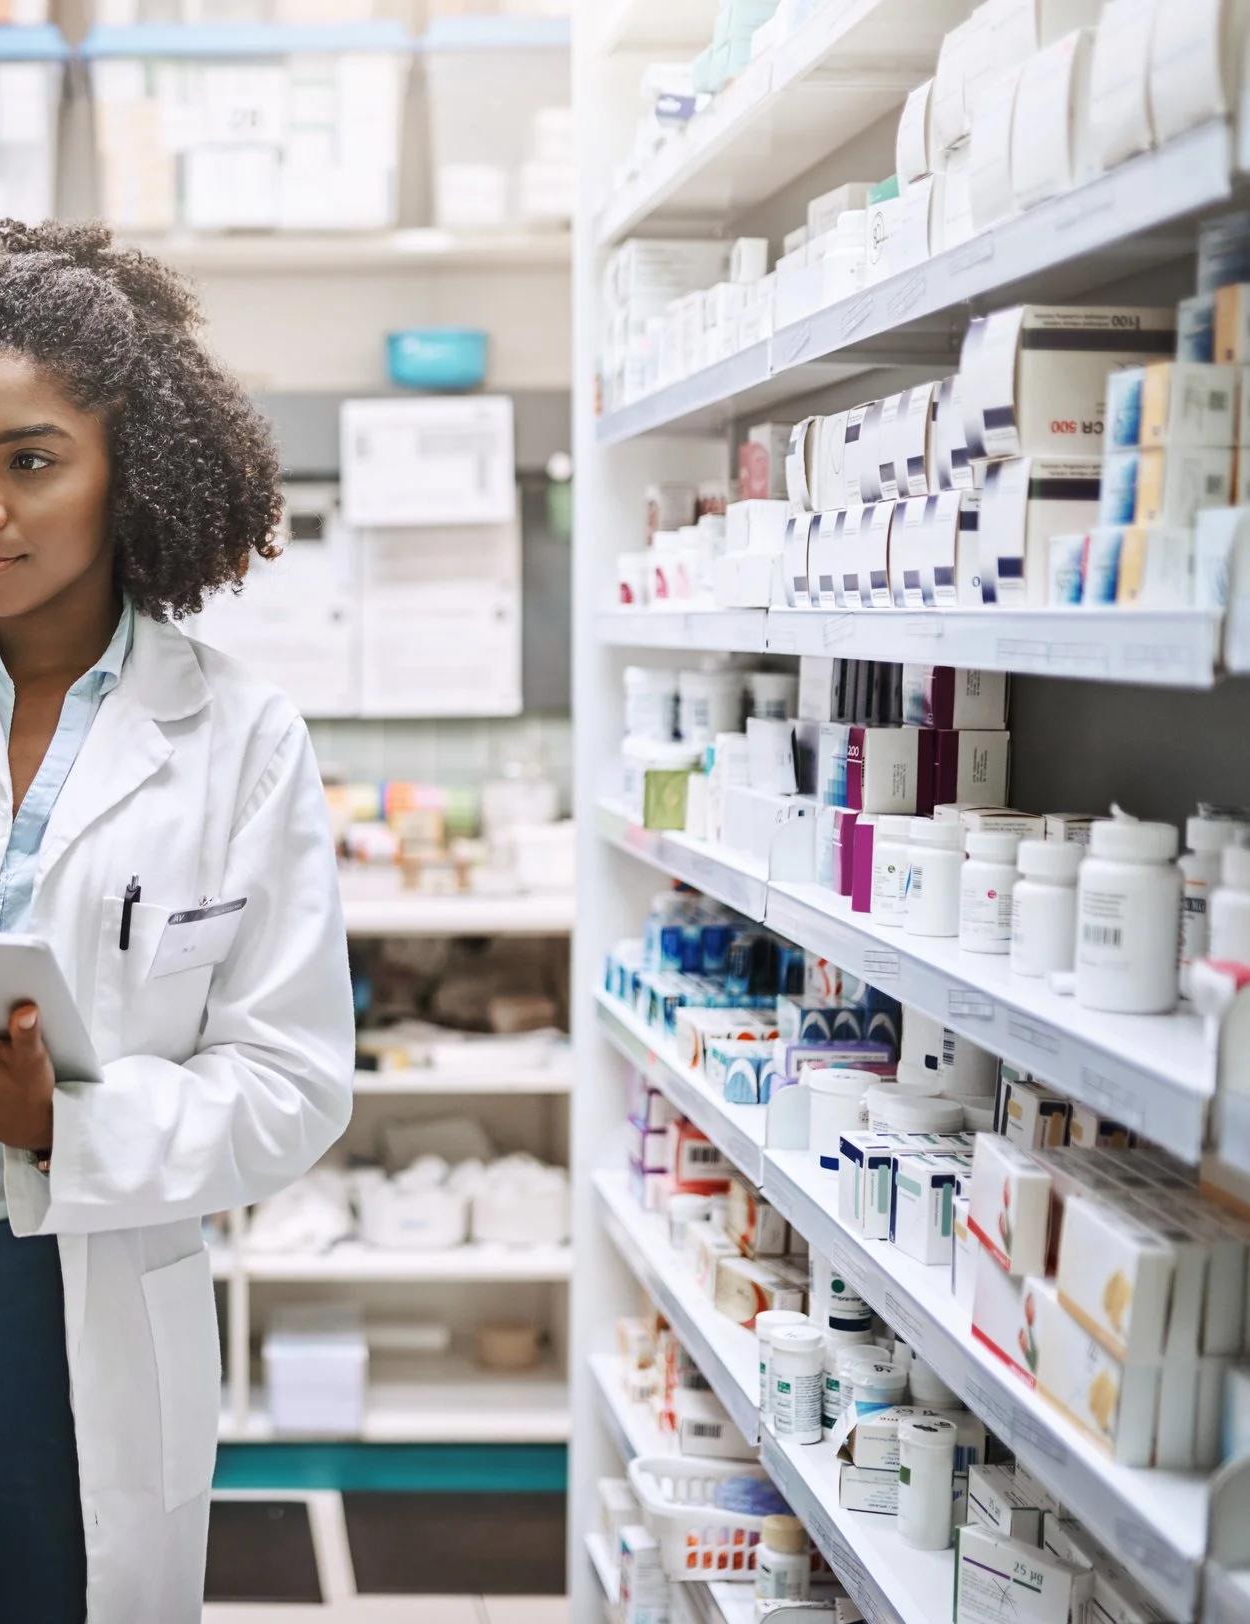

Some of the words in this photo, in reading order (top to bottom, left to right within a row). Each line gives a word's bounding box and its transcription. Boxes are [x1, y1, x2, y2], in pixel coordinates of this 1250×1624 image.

[1051, 421, 1078, 433] 500
[1082, 421, 1104, 434] CR
[848, 745, 860, 757] 200
[1013, 1561, 1027, 1576] 25
[1030, 1571, 1044, 1585] µg
